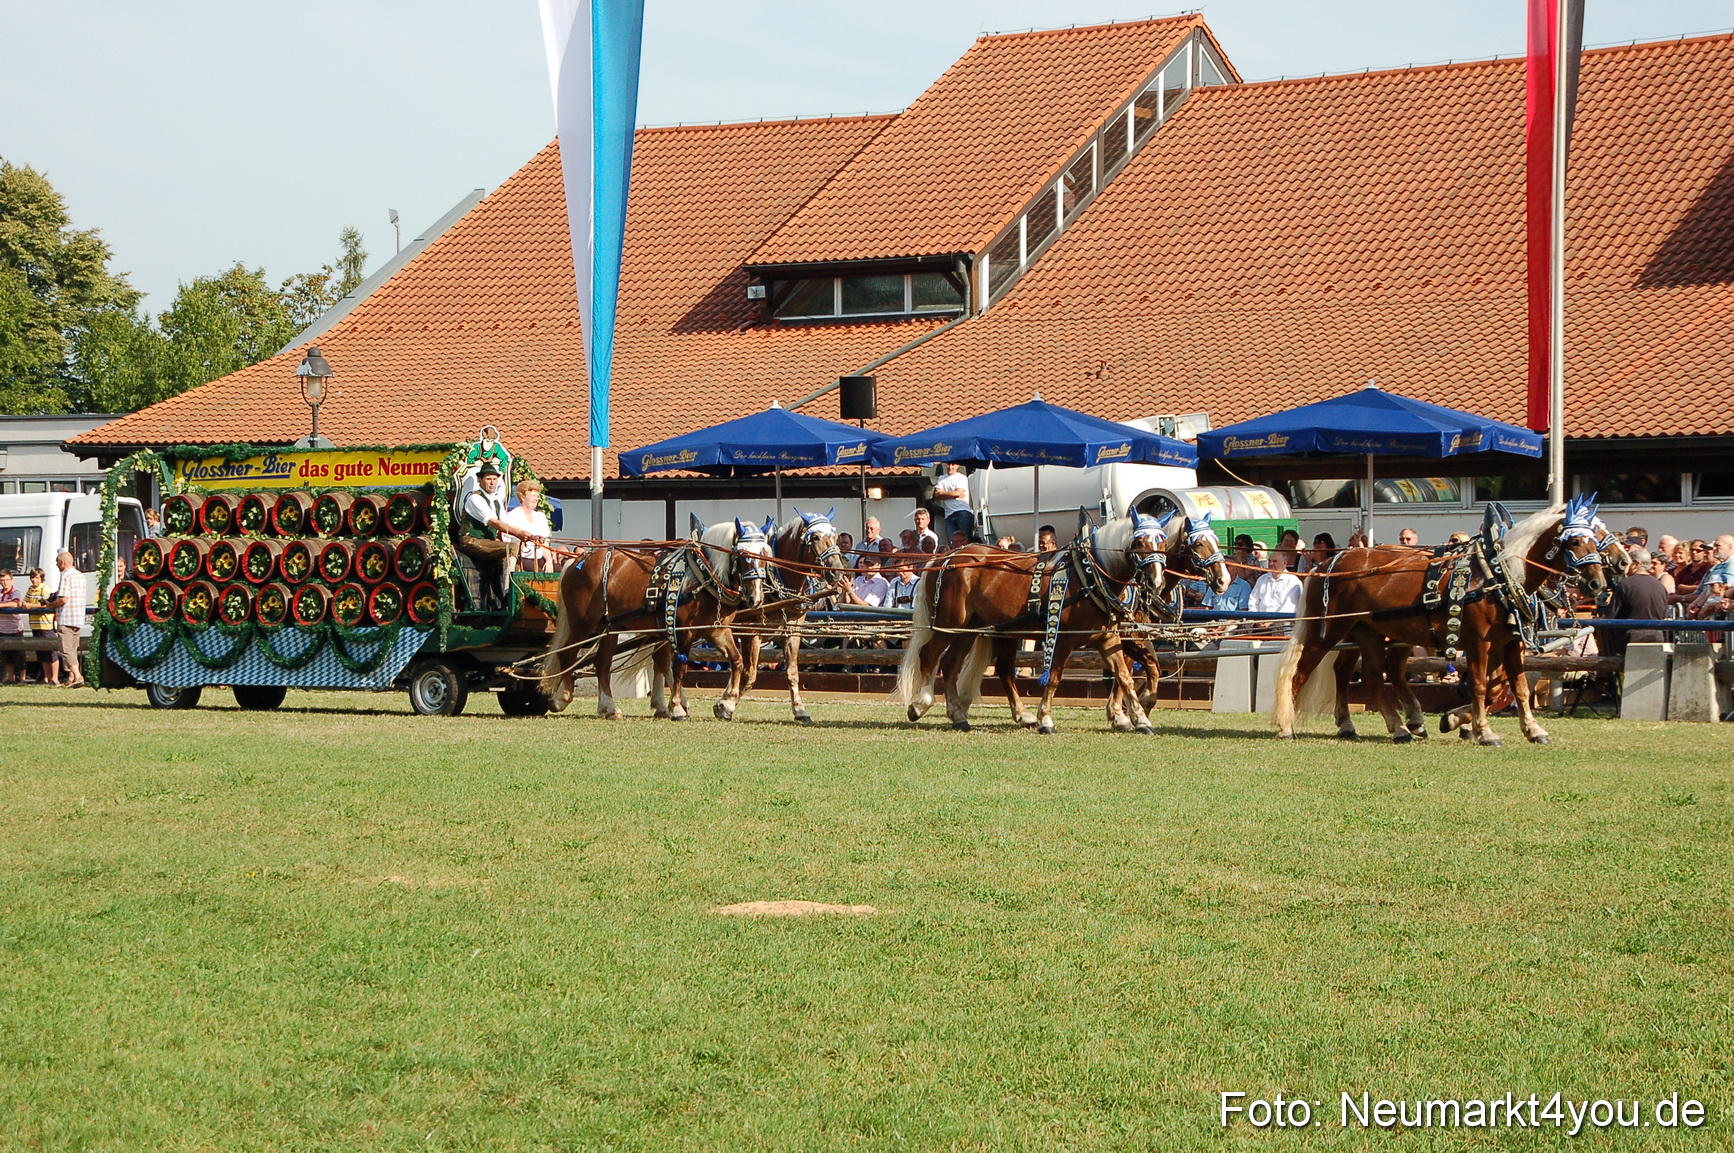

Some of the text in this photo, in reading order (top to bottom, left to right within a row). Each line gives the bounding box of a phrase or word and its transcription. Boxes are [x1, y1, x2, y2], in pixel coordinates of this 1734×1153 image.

[894, 442, 953, 464] Glossner-Bier
[1223, 433, 1289, 455] Glossner-Bier
[181, 455, 440, 483] Glossner-Bier das gute Neuma
[641, 449, 698, 471] Glossner-Bier
